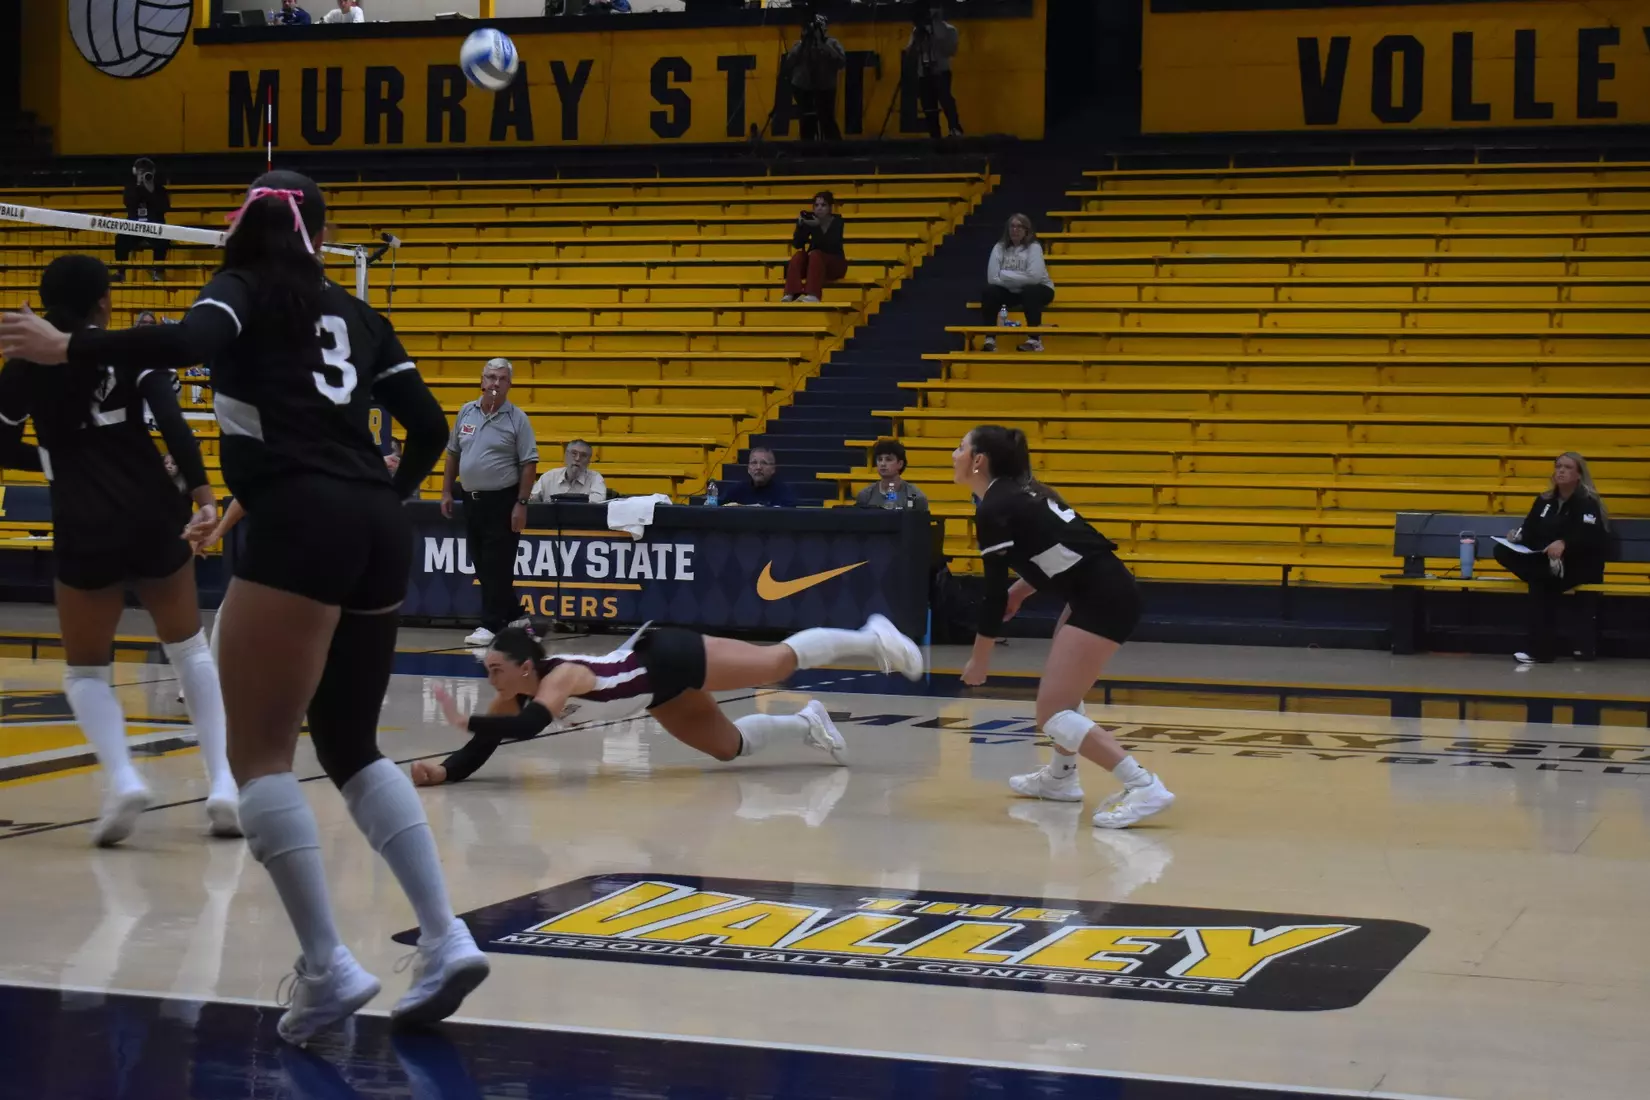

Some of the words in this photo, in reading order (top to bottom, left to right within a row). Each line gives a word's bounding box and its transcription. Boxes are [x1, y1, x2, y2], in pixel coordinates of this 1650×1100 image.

[1297, 26, 1650, 125] VOLLE
[228, 59, 594, 148] MURRAY
[0, 206, 19, 218] BALL
[97, 219, 119, 230] RACER
[119, 222, 158, 236] VOLLEYBALL
[311, 314, 358, 406] 3
[424, 537, 581, 578] MURAY
[585, 542, 695, 581] STATE
[519, 594, 619, 618] ACERS
[968, 735, 1650, 775] VLLEYBALL
[522, 880, 1362, 982] VALLEY
[857, 897, 1080, 922] THE
[498, 934, 720, 958] MISSOURI
[742, 951, 903, 970] VALLEY
[916, 962, 1237, 995] CONFERENCE
